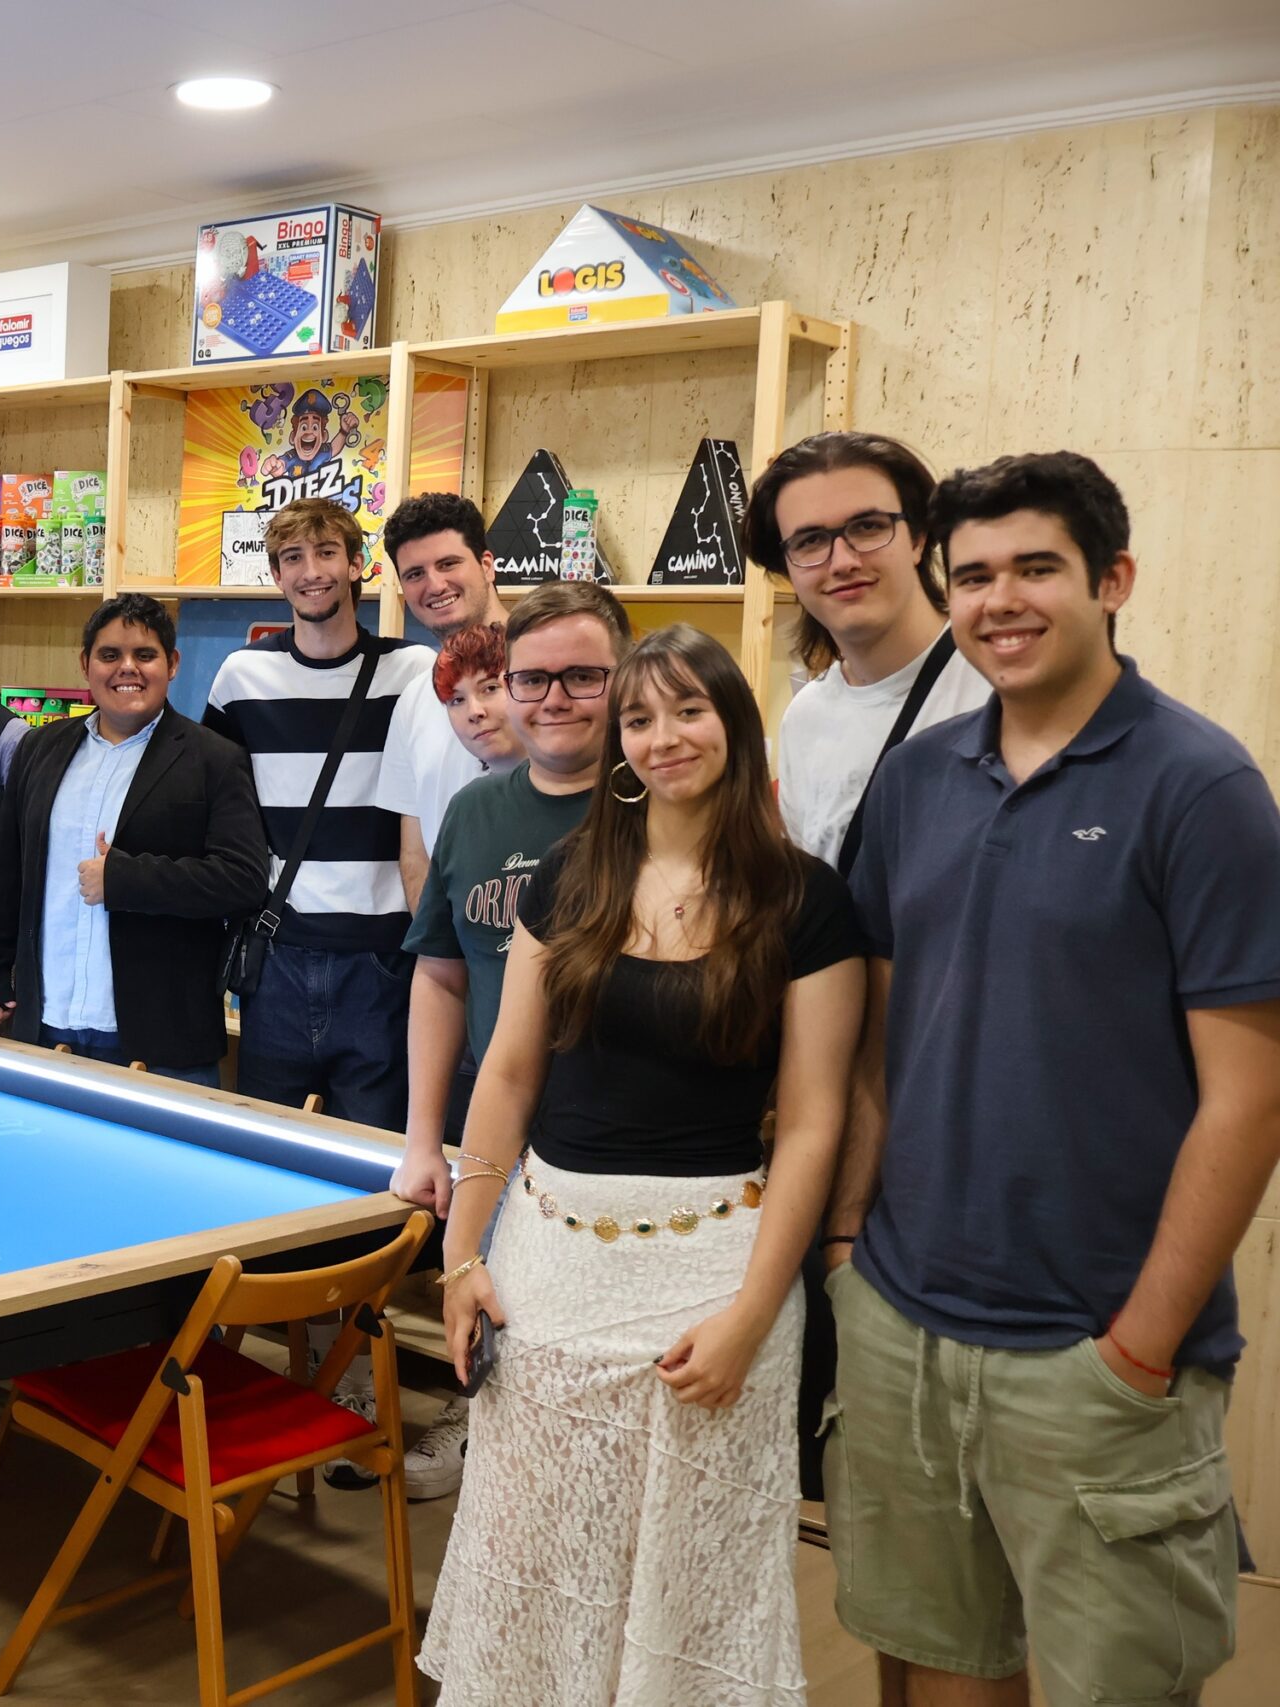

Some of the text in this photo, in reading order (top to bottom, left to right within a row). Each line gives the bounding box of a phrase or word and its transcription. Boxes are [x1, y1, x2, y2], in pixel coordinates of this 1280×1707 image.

[277, 220, 324, 240] Bingo
[291, 238, 323, 247] PREMIUM
[339, 218, 349, 258] Bingo
[538, 260, 625, 297] LOGIS
[0, 318, 30, 332] falomir
[26, 481, 47, 493] DICE
[78, 478, 100, 490] DICE
[262, 460, 343, 511] DIEZ
[564, 510, 589, 522] DICE
[5, 528, 24, 538] DICE
[63, 528, 83, 538] DICE
[493, 553, 560, 576] CAMiN
